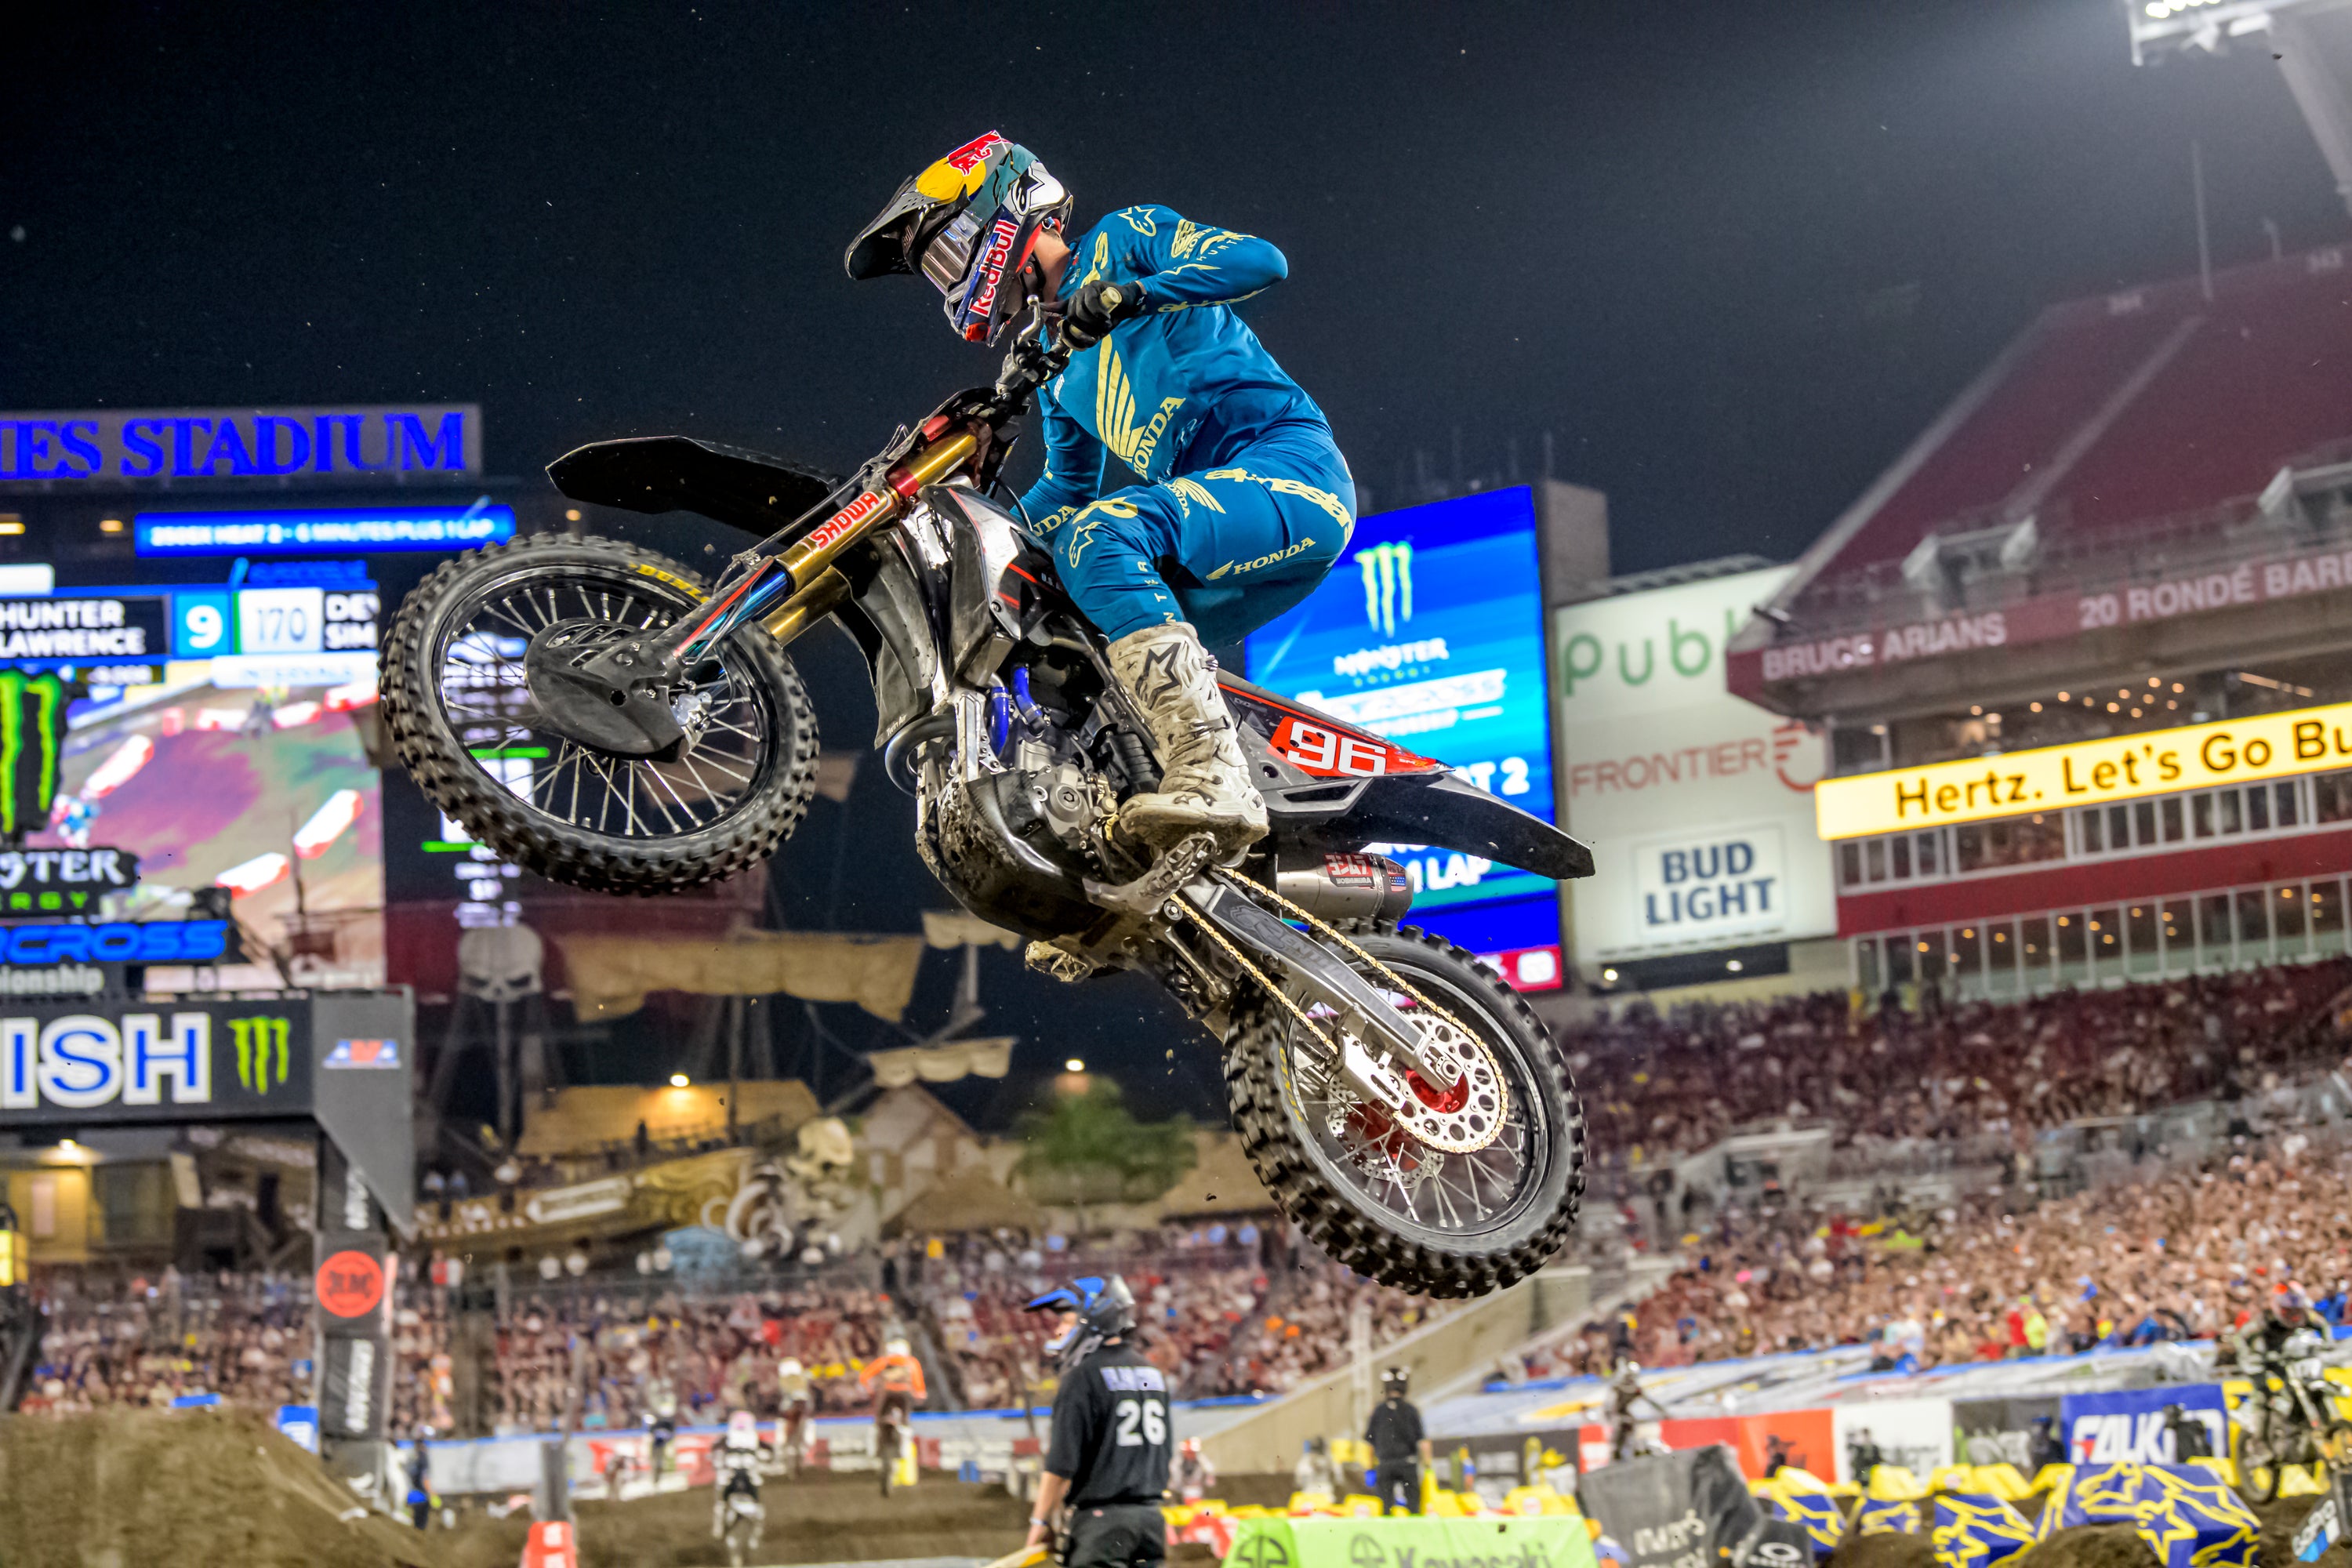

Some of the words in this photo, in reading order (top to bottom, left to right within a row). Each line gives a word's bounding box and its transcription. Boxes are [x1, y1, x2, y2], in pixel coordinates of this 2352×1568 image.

[0, 419, 103, 480] ES
[121, 412, 466, 477] STADIUM
[1134, 396, 1186, 481] HONDA
[808, 491, 880, 550] SHOWA
[1232, 537, 1316, 575] HONDA
[0, 600, 125, 631] HUNTER
[2079, 593, 2118, 630] 20
[2127, 561, 2257, 621] RONDÉ
[0, 627, 147, 659] LAWRENCE
[185, 604, 224, 649] 9
[256, 608, 307, 643] 170
[1762, 633, 1874, 681] BRUCE
[1882, 612, 2007, 662] ARIANS
[1287, 720, 1387, 778] 96
[1570, 738, 1767, 797] FRONTIER
[1895, 771, 2044, 818] Hertz.
[2063, 743, 2181, 794] Let's
[2201, 732, 2272, 772] Go
[1501, 756, 1530, 796] 2
[1426, 853, 1493, 891] LAP
[1662, 841, 1755, 885] BUD
[1646, 877, 1777, 926] LIGHT
[0, 1011, 212, 1109] ISH
[1116, 1399, 1167, 1446] 26
[2072, 1408, 2226, 1465] FALK
